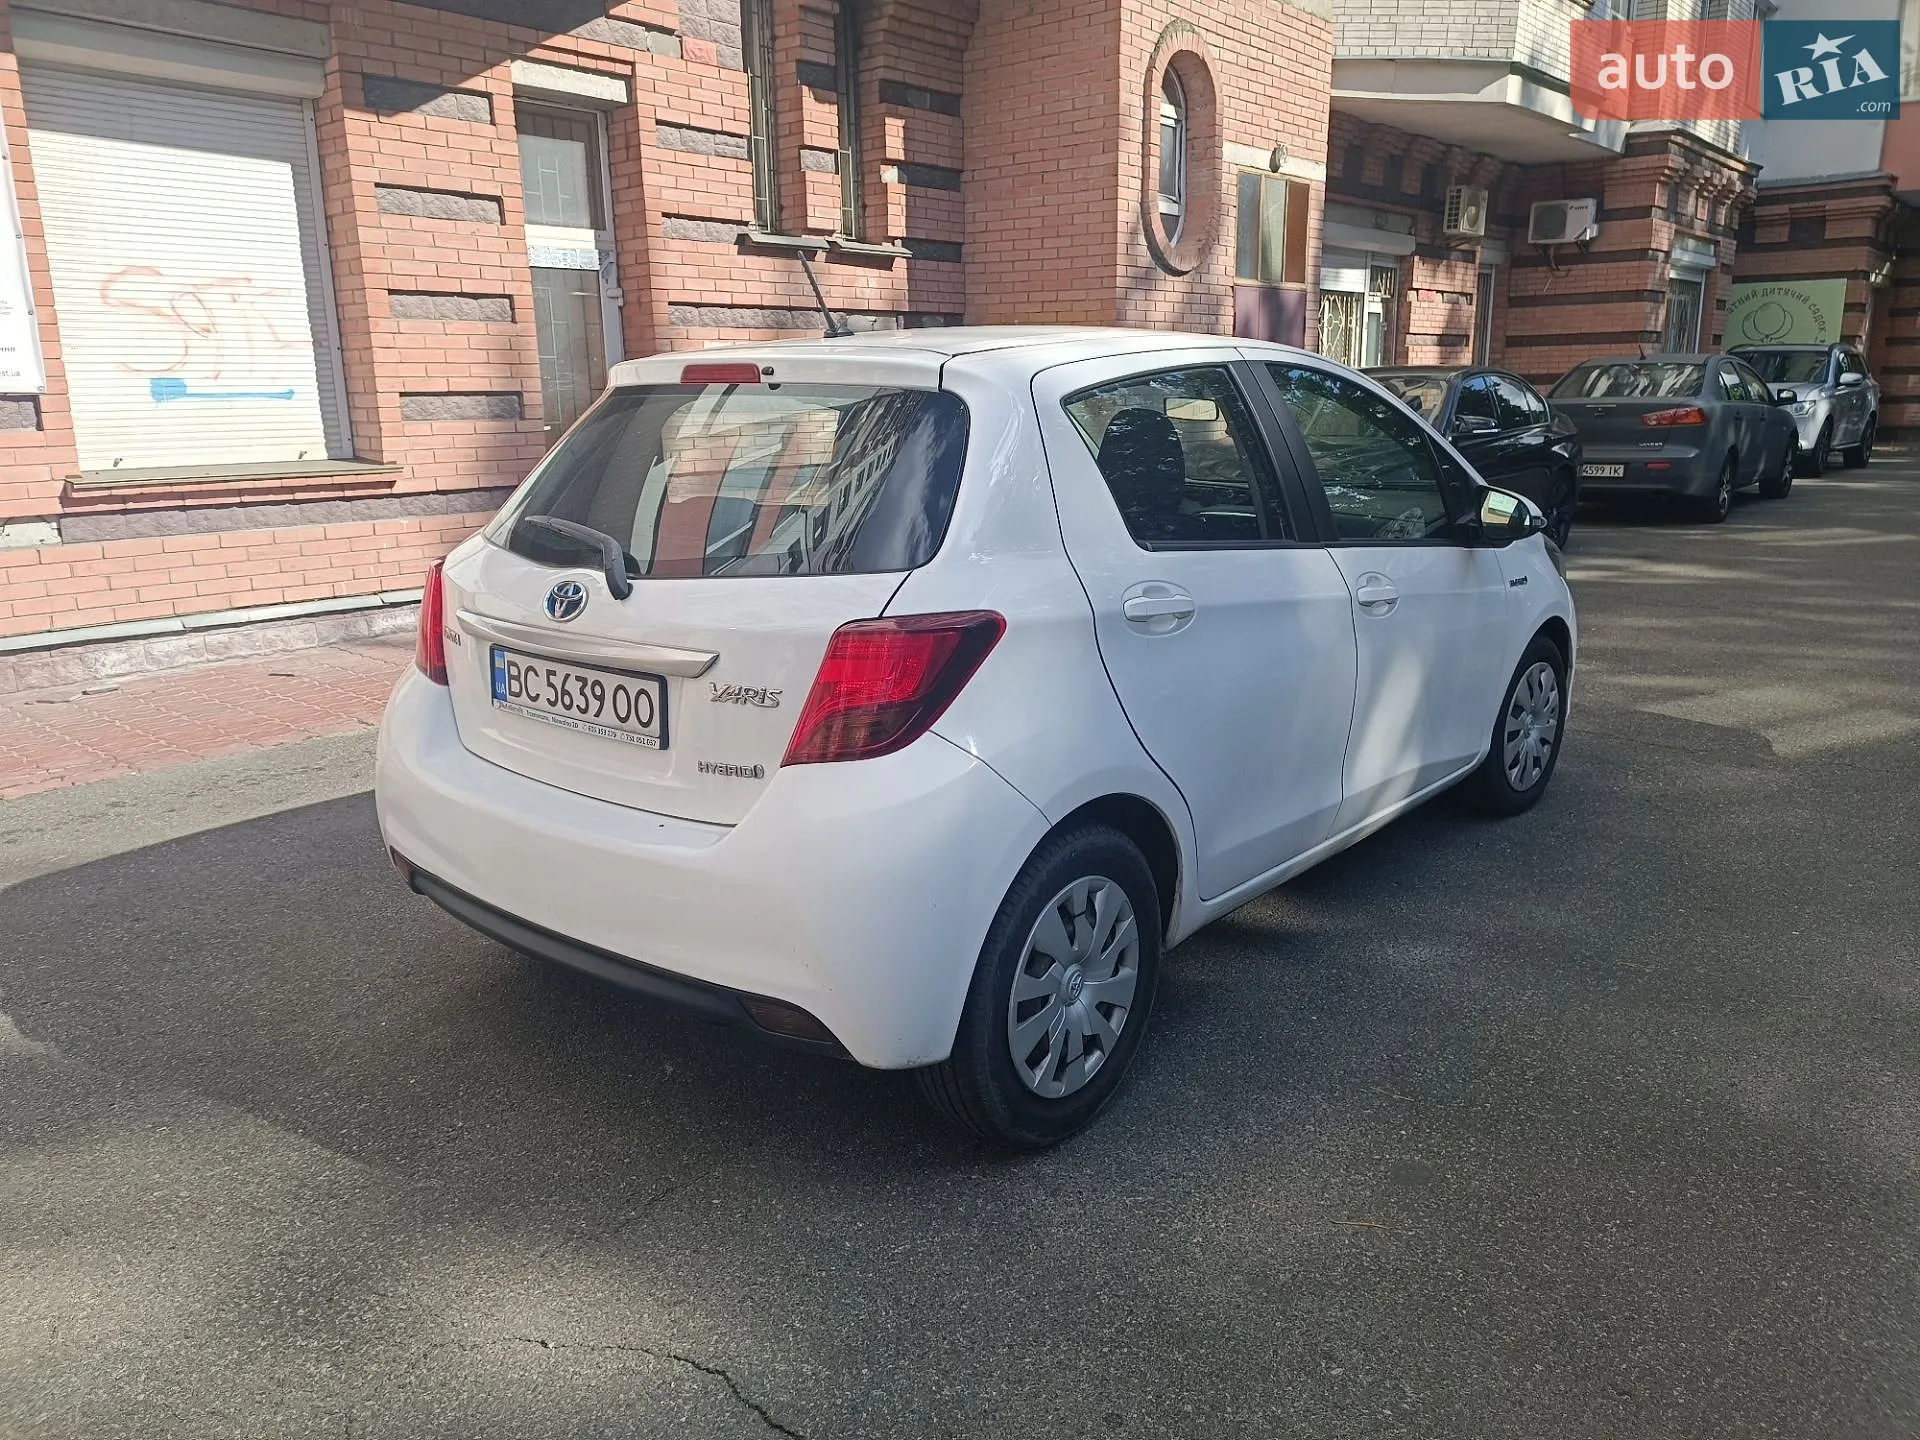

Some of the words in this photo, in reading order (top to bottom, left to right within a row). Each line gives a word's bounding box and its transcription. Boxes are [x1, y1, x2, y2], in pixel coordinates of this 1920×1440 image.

[495, 682, 506, 695] UA
[507, 660, 540, 702] BC
[546, 668, 605, 718] 5639
[709, 682, 783, 709] YARIS
